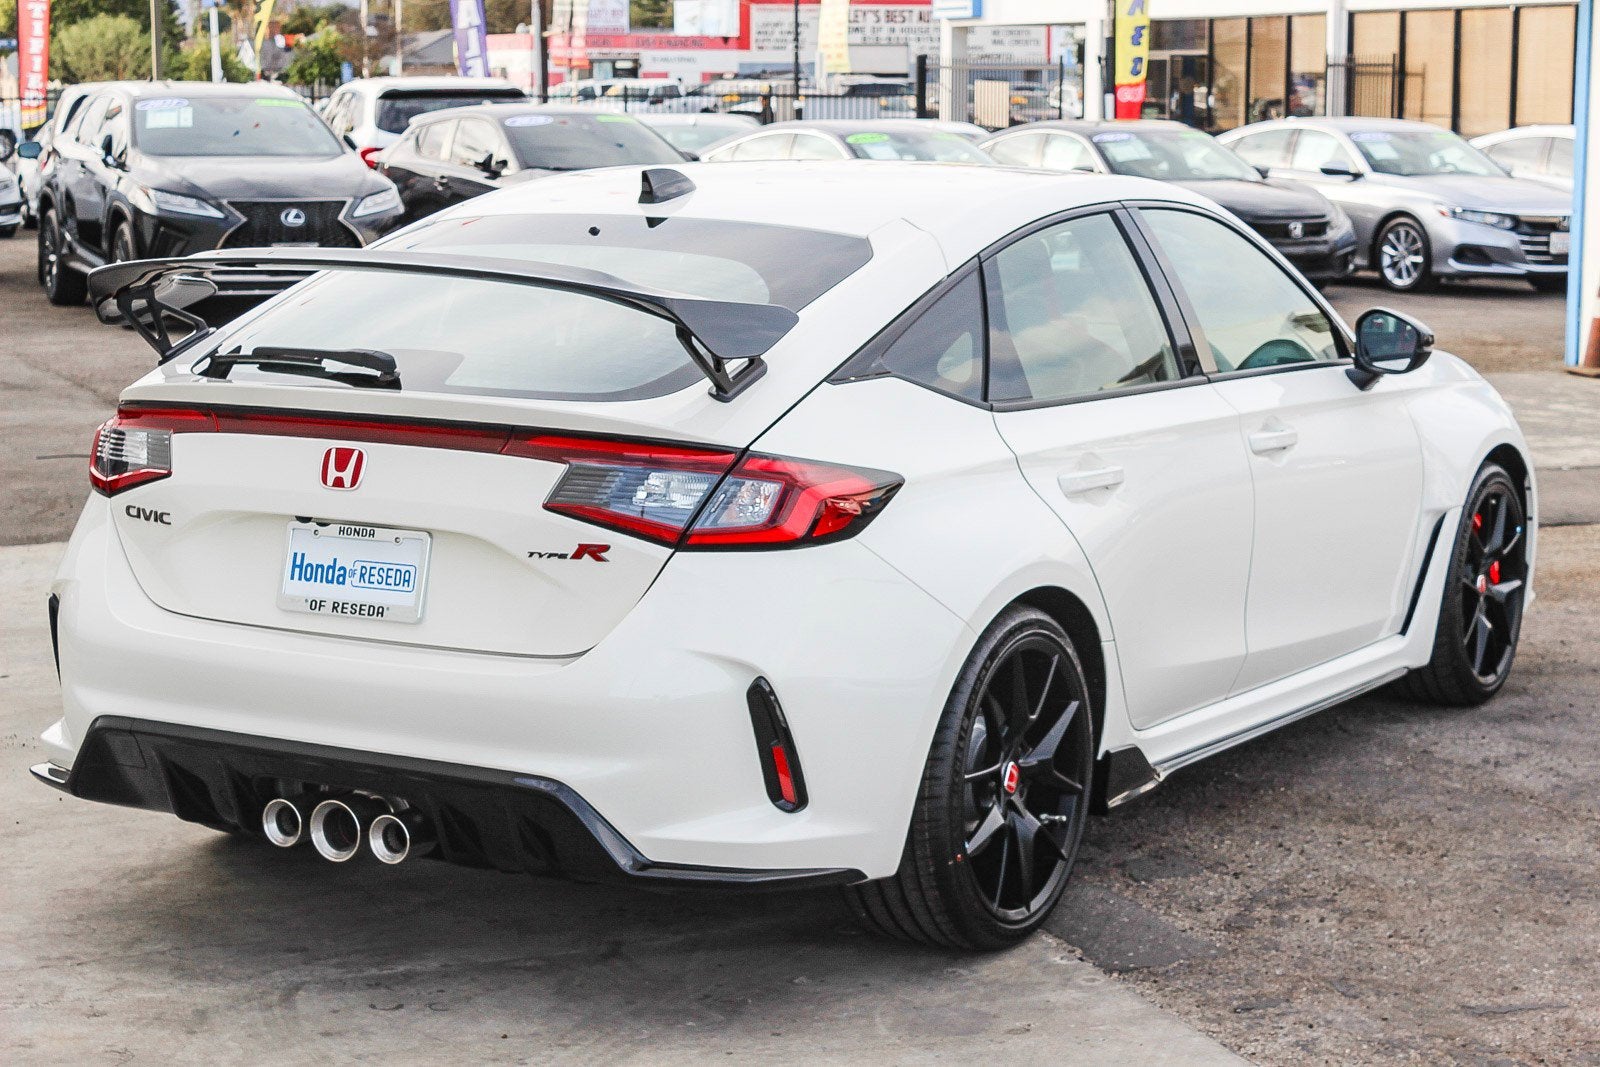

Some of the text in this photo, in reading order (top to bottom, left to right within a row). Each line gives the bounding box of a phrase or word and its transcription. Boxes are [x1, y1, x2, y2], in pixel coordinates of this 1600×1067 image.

[885, 8, 914, 24] BEST
[125, 504, 172, 526] CIVIC
[338, 526, 376, 538] HONDA
[527, 543, 611, 563] TYPE R
[290, 552, 411, 588] Honda OF RESEDA
[309, 599, 385, 618] OF RESEDA
